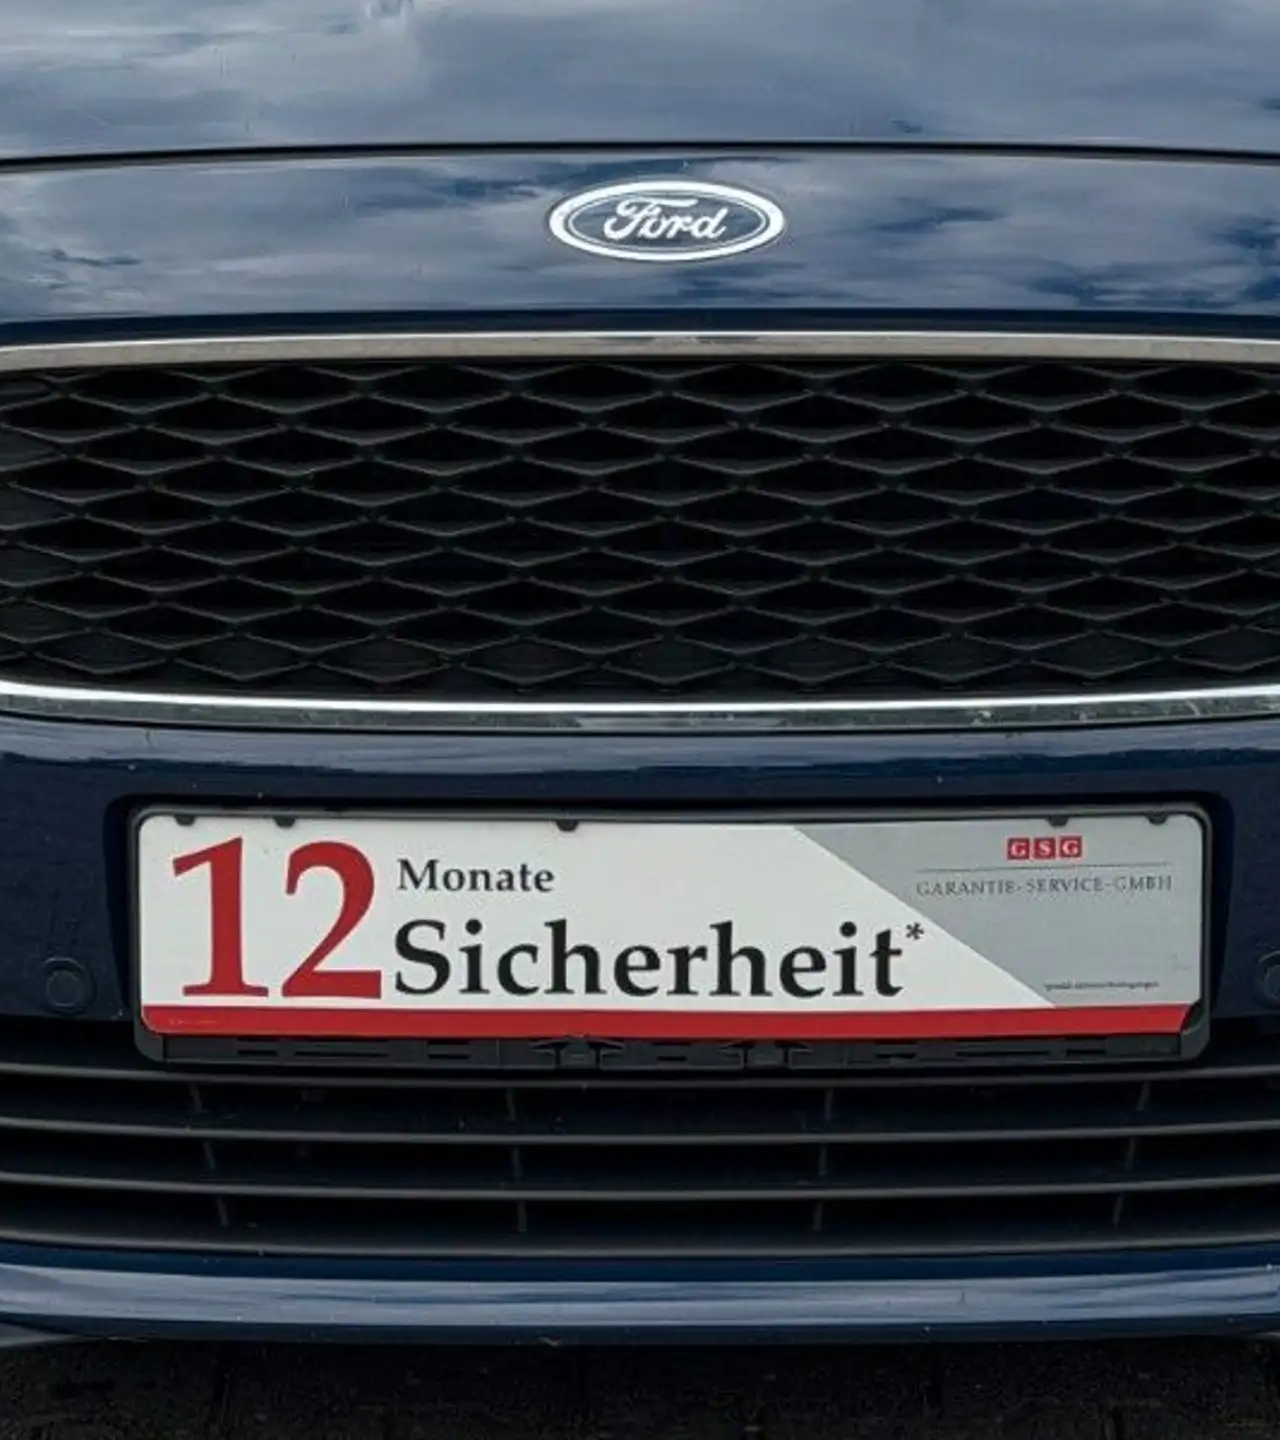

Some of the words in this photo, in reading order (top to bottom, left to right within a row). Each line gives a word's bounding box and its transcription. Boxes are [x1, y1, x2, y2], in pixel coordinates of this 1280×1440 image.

[603, 197, 728, 240] Ford
[1009, 838, 1081, 859] GSG
[398, 858, 555, 893] Monate
[171, 837, 382, 999] 12
